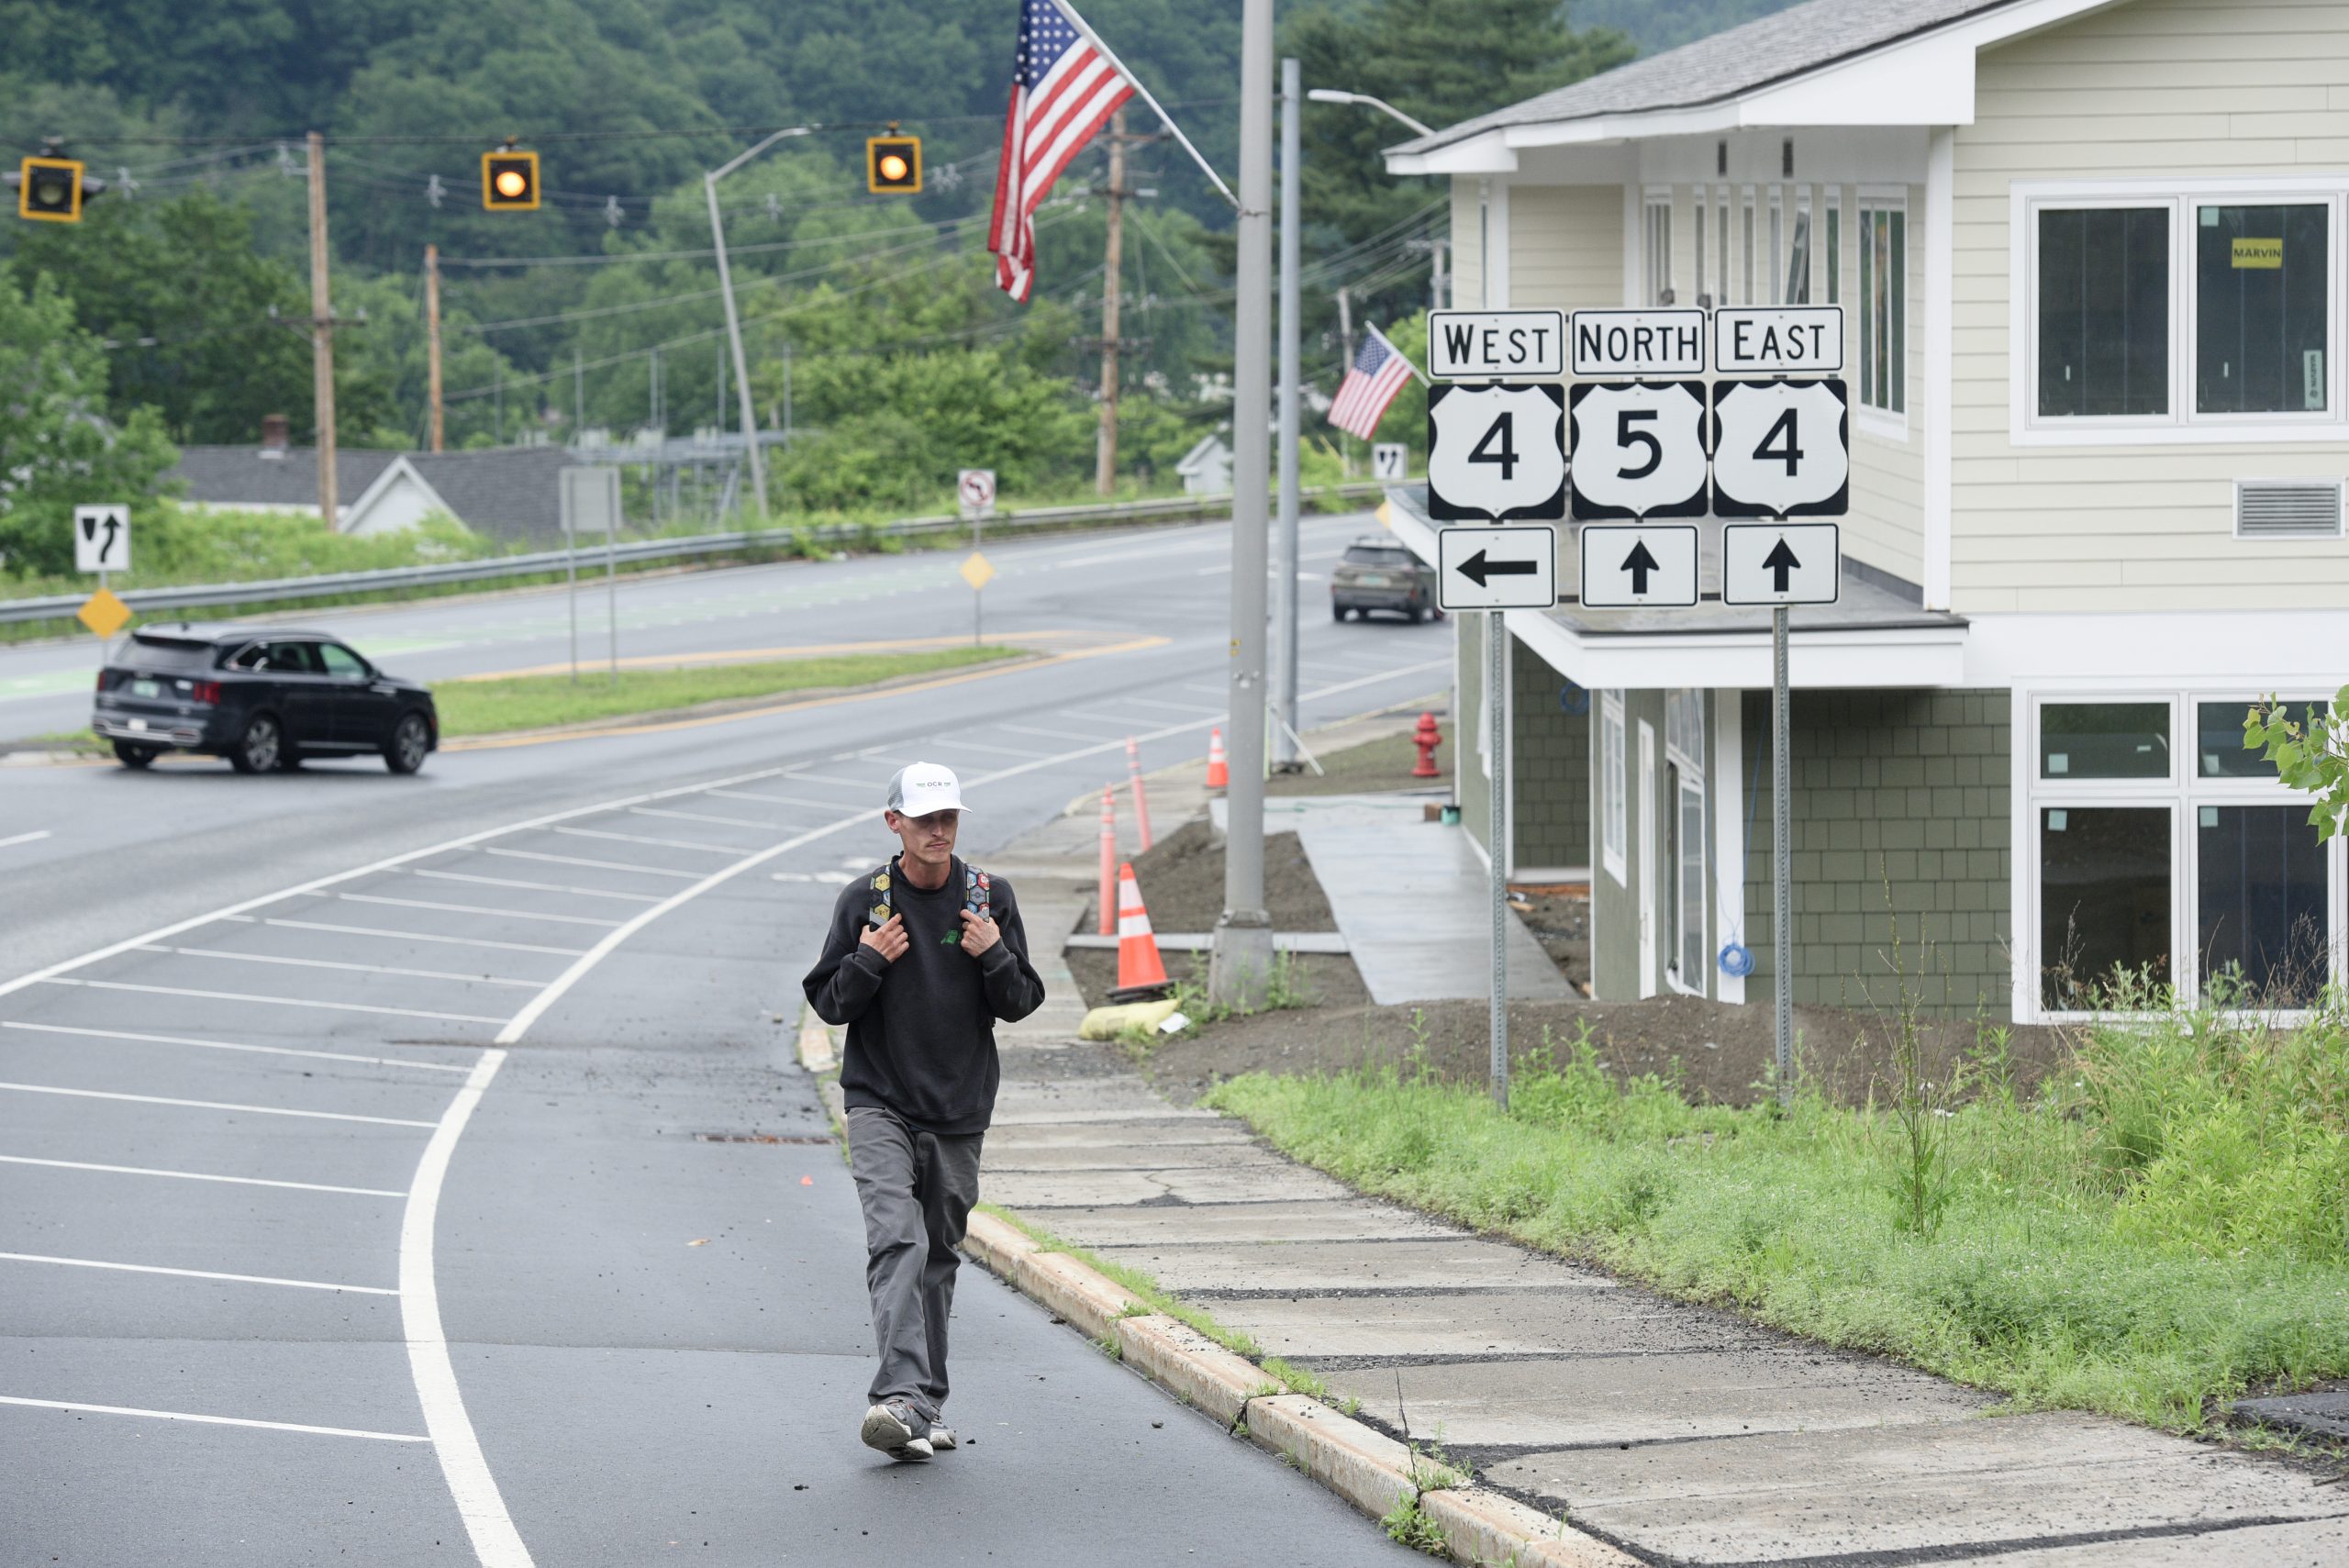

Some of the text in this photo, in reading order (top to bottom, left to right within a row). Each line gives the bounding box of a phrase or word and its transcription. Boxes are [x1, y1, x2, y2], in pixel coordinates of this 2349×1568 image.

[2233, 248, 2281, 258] MARVIN
[1444, 324, 1550, 364] WEST
[1579, 324, 1698, 362] NORTH
[1733, 320, 1826, 361] EAST
[1467, 411, 1520, 481] 4
[1616, 409, 1663, 480] 5
[1752, 407, 1804, 477] 4
